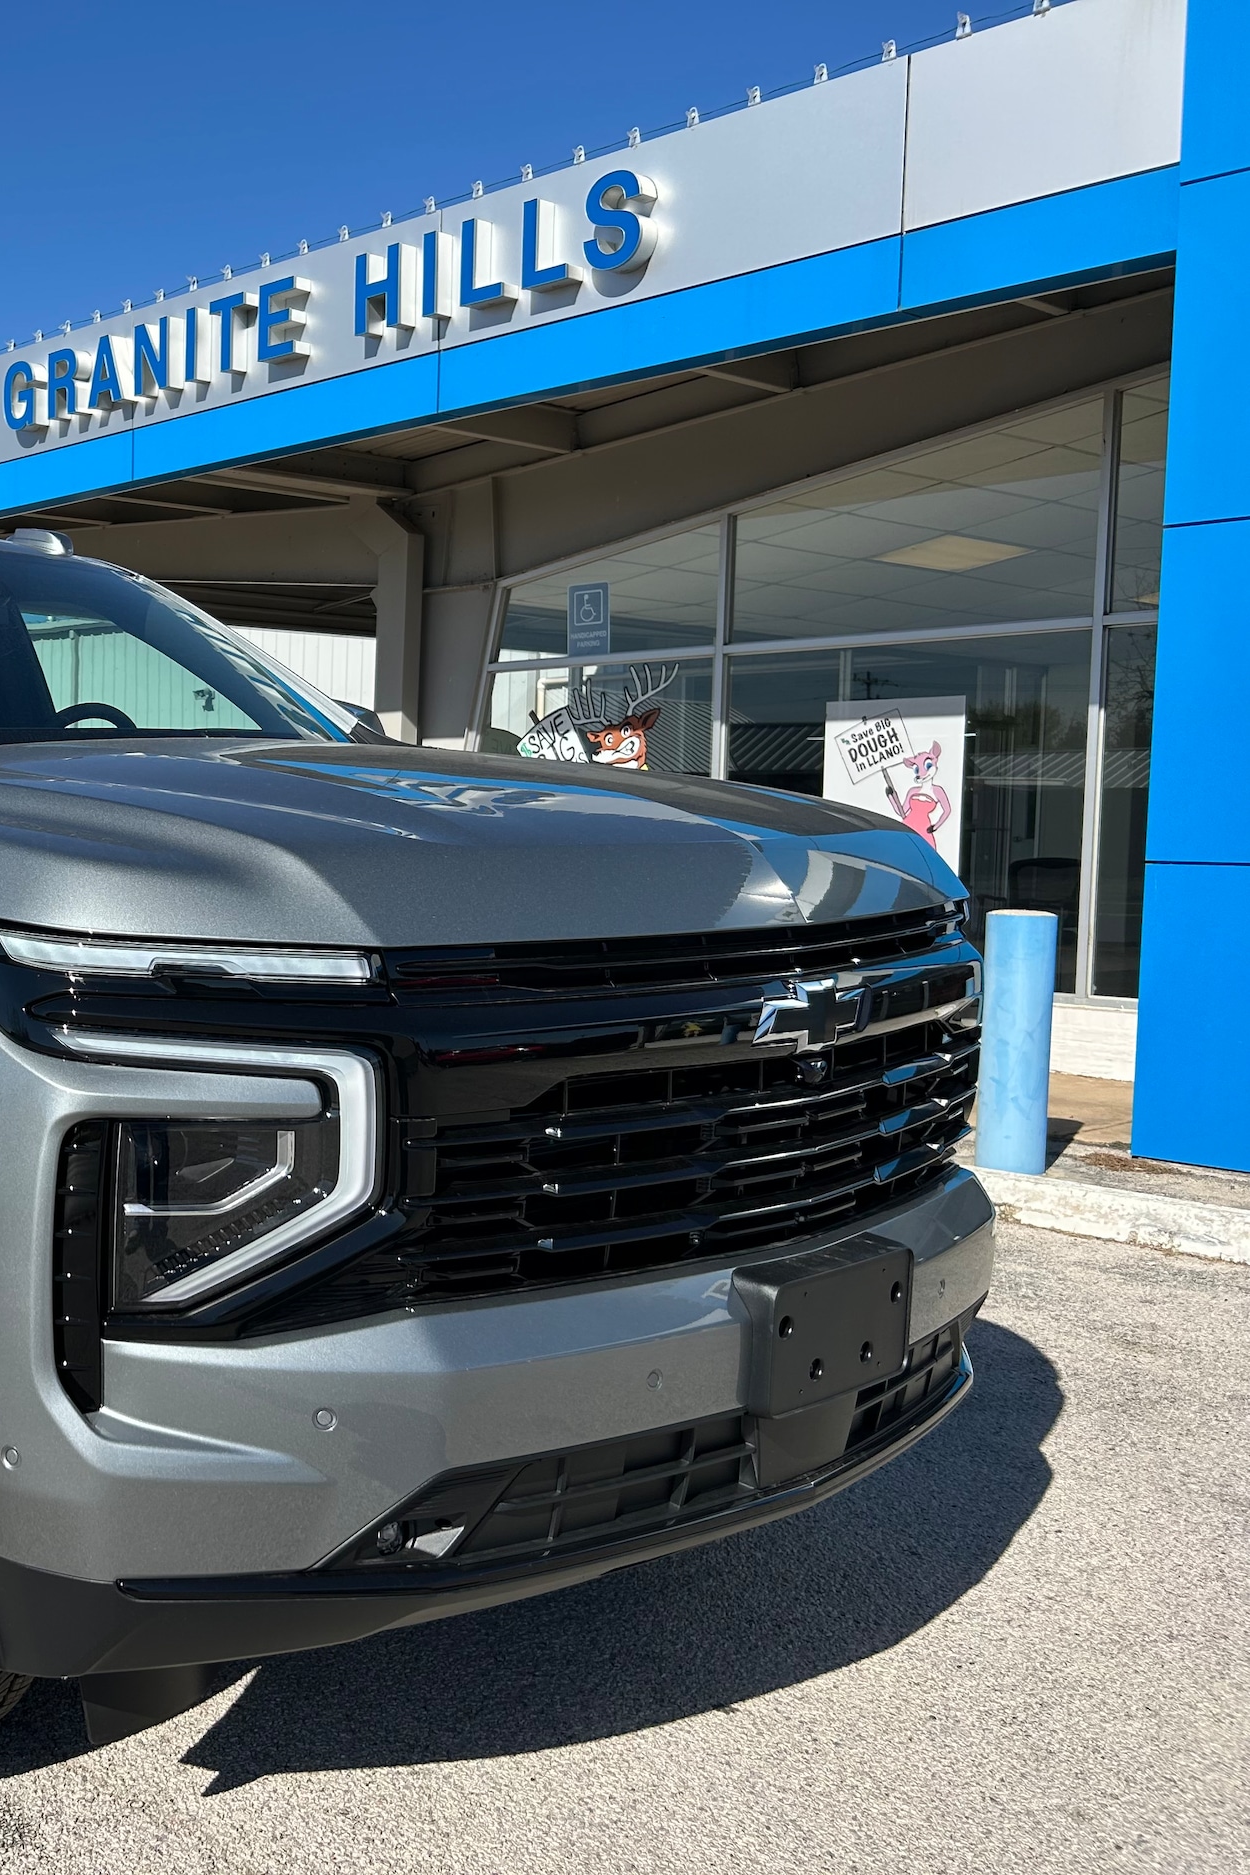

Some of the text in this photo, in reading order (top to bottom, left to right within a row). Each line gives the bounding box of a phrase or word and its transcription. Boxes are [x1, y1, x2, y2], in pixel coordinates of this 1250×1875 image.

[4, 169, 656, 432] GRANITE HILLS
[570, 630, 607, 639] HANDICAPPED
[576, 640, 600, 648] PARKING
[528, 713, 570, 754] SAVE
[850, 727, 874, 743] Save
[874, 717, 892, 732] BIG
[538, 736, 575, 762] IG
[847, 727, 899, 763] DOUGH
[866, 743, 904, 767] LLANO!
